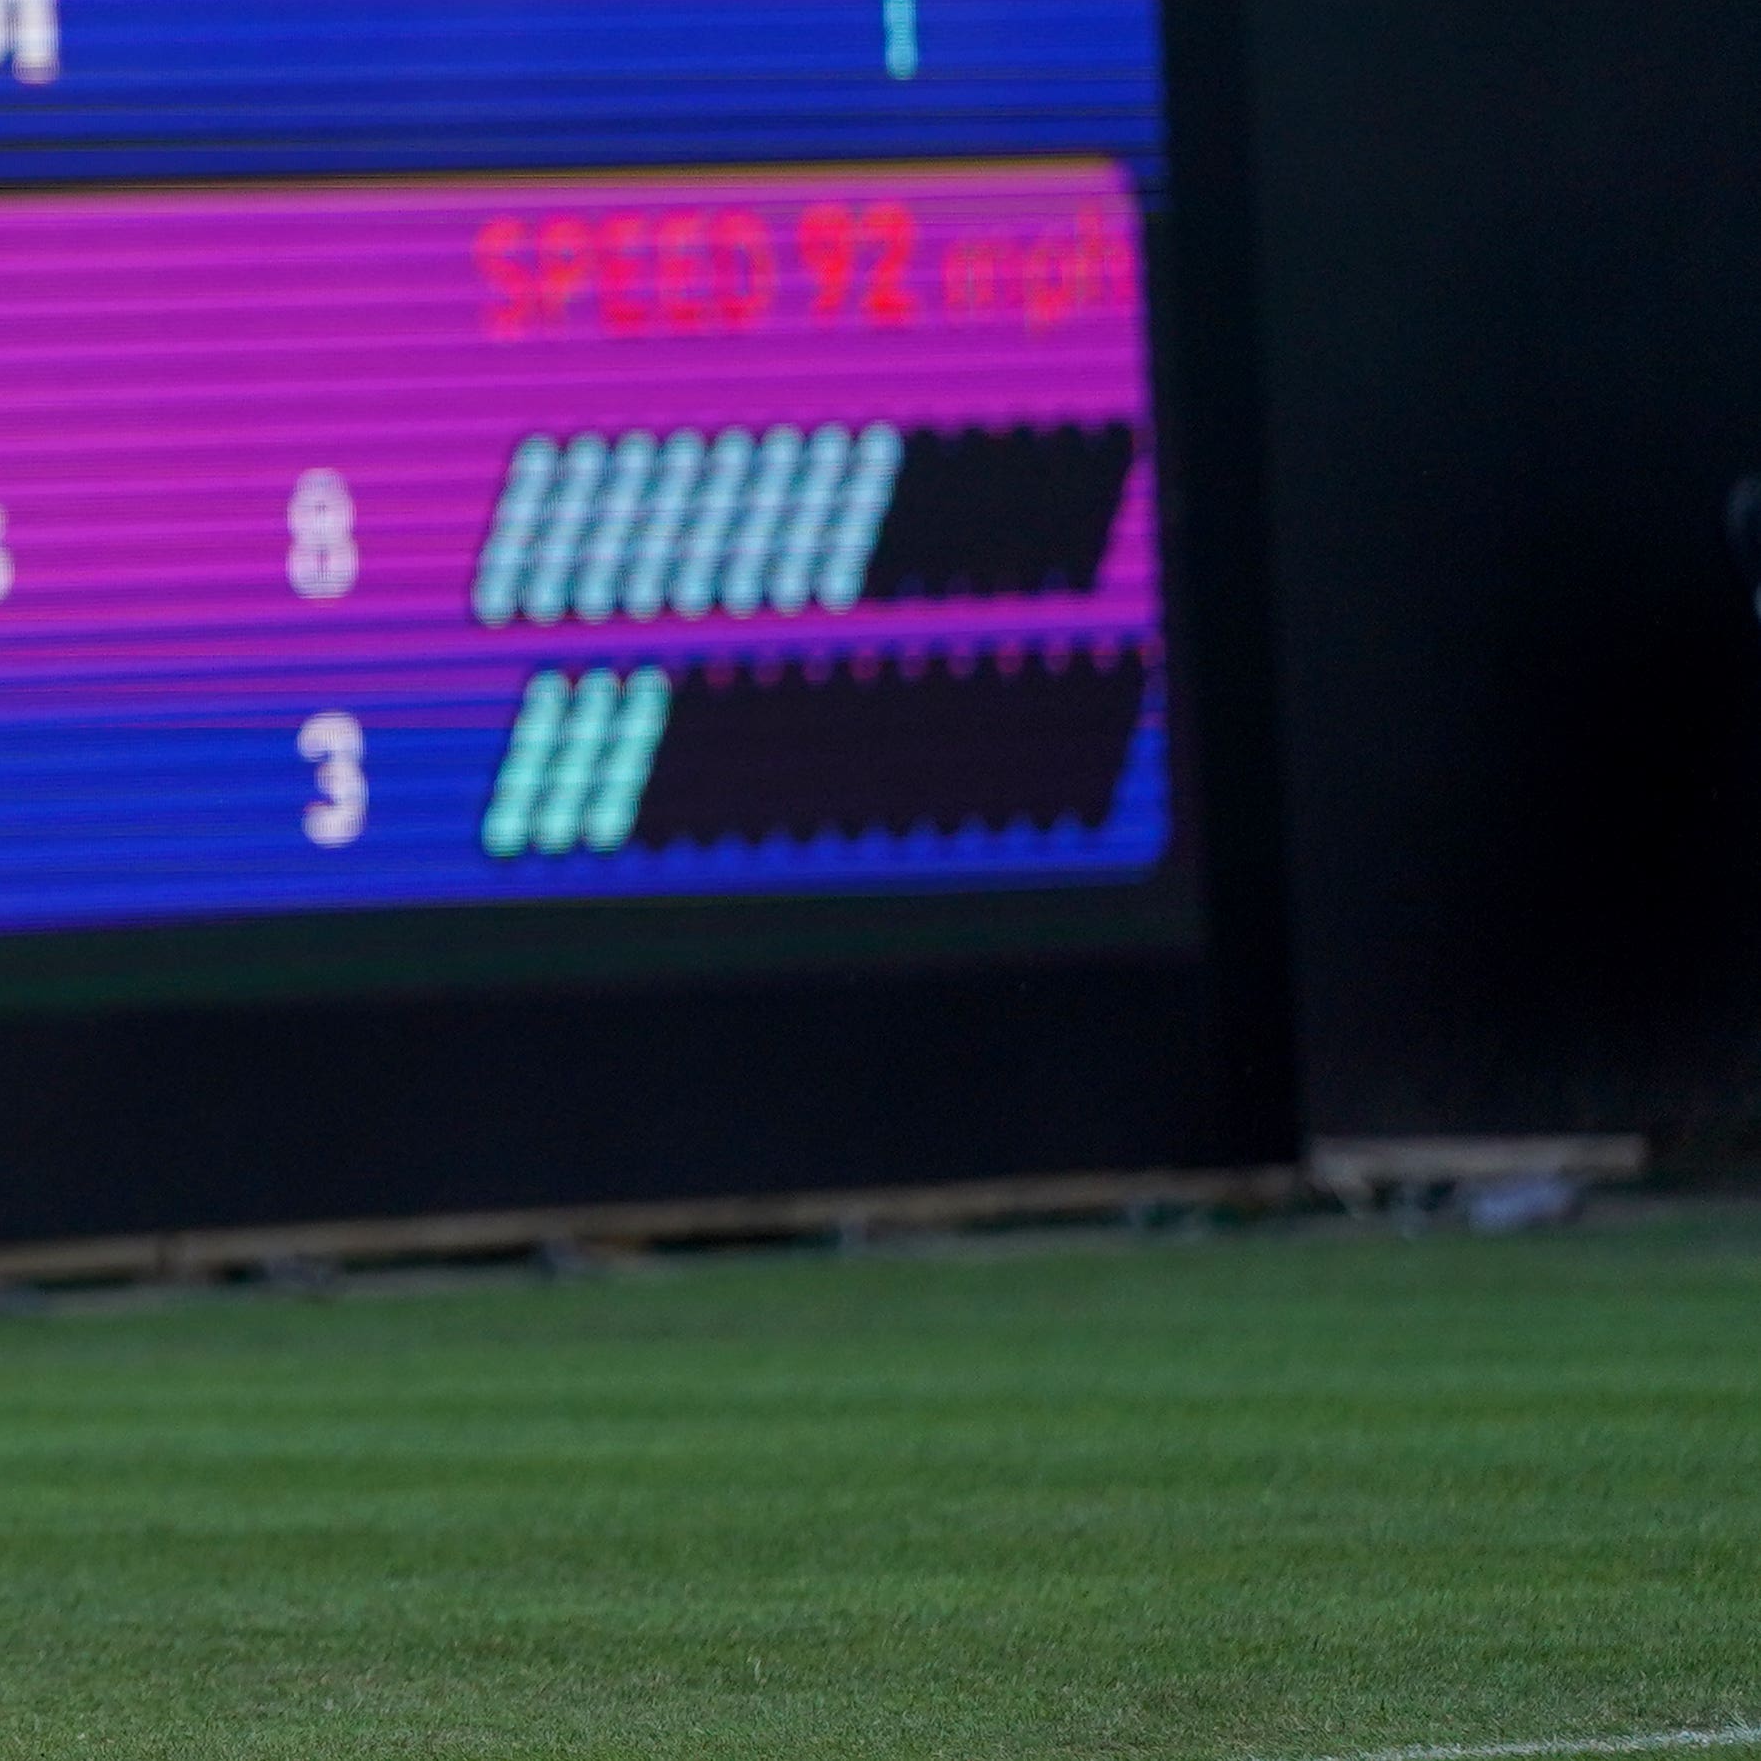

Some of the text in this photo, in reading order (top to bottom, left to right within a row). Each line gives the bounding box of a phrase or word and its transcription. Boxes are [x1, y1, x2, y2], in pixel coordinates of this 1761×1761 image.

[476, 201, 1135, 341] SPEED 92 mph
[286, 467, 358, 600] 8
[297, 710, 368, 847] 3
